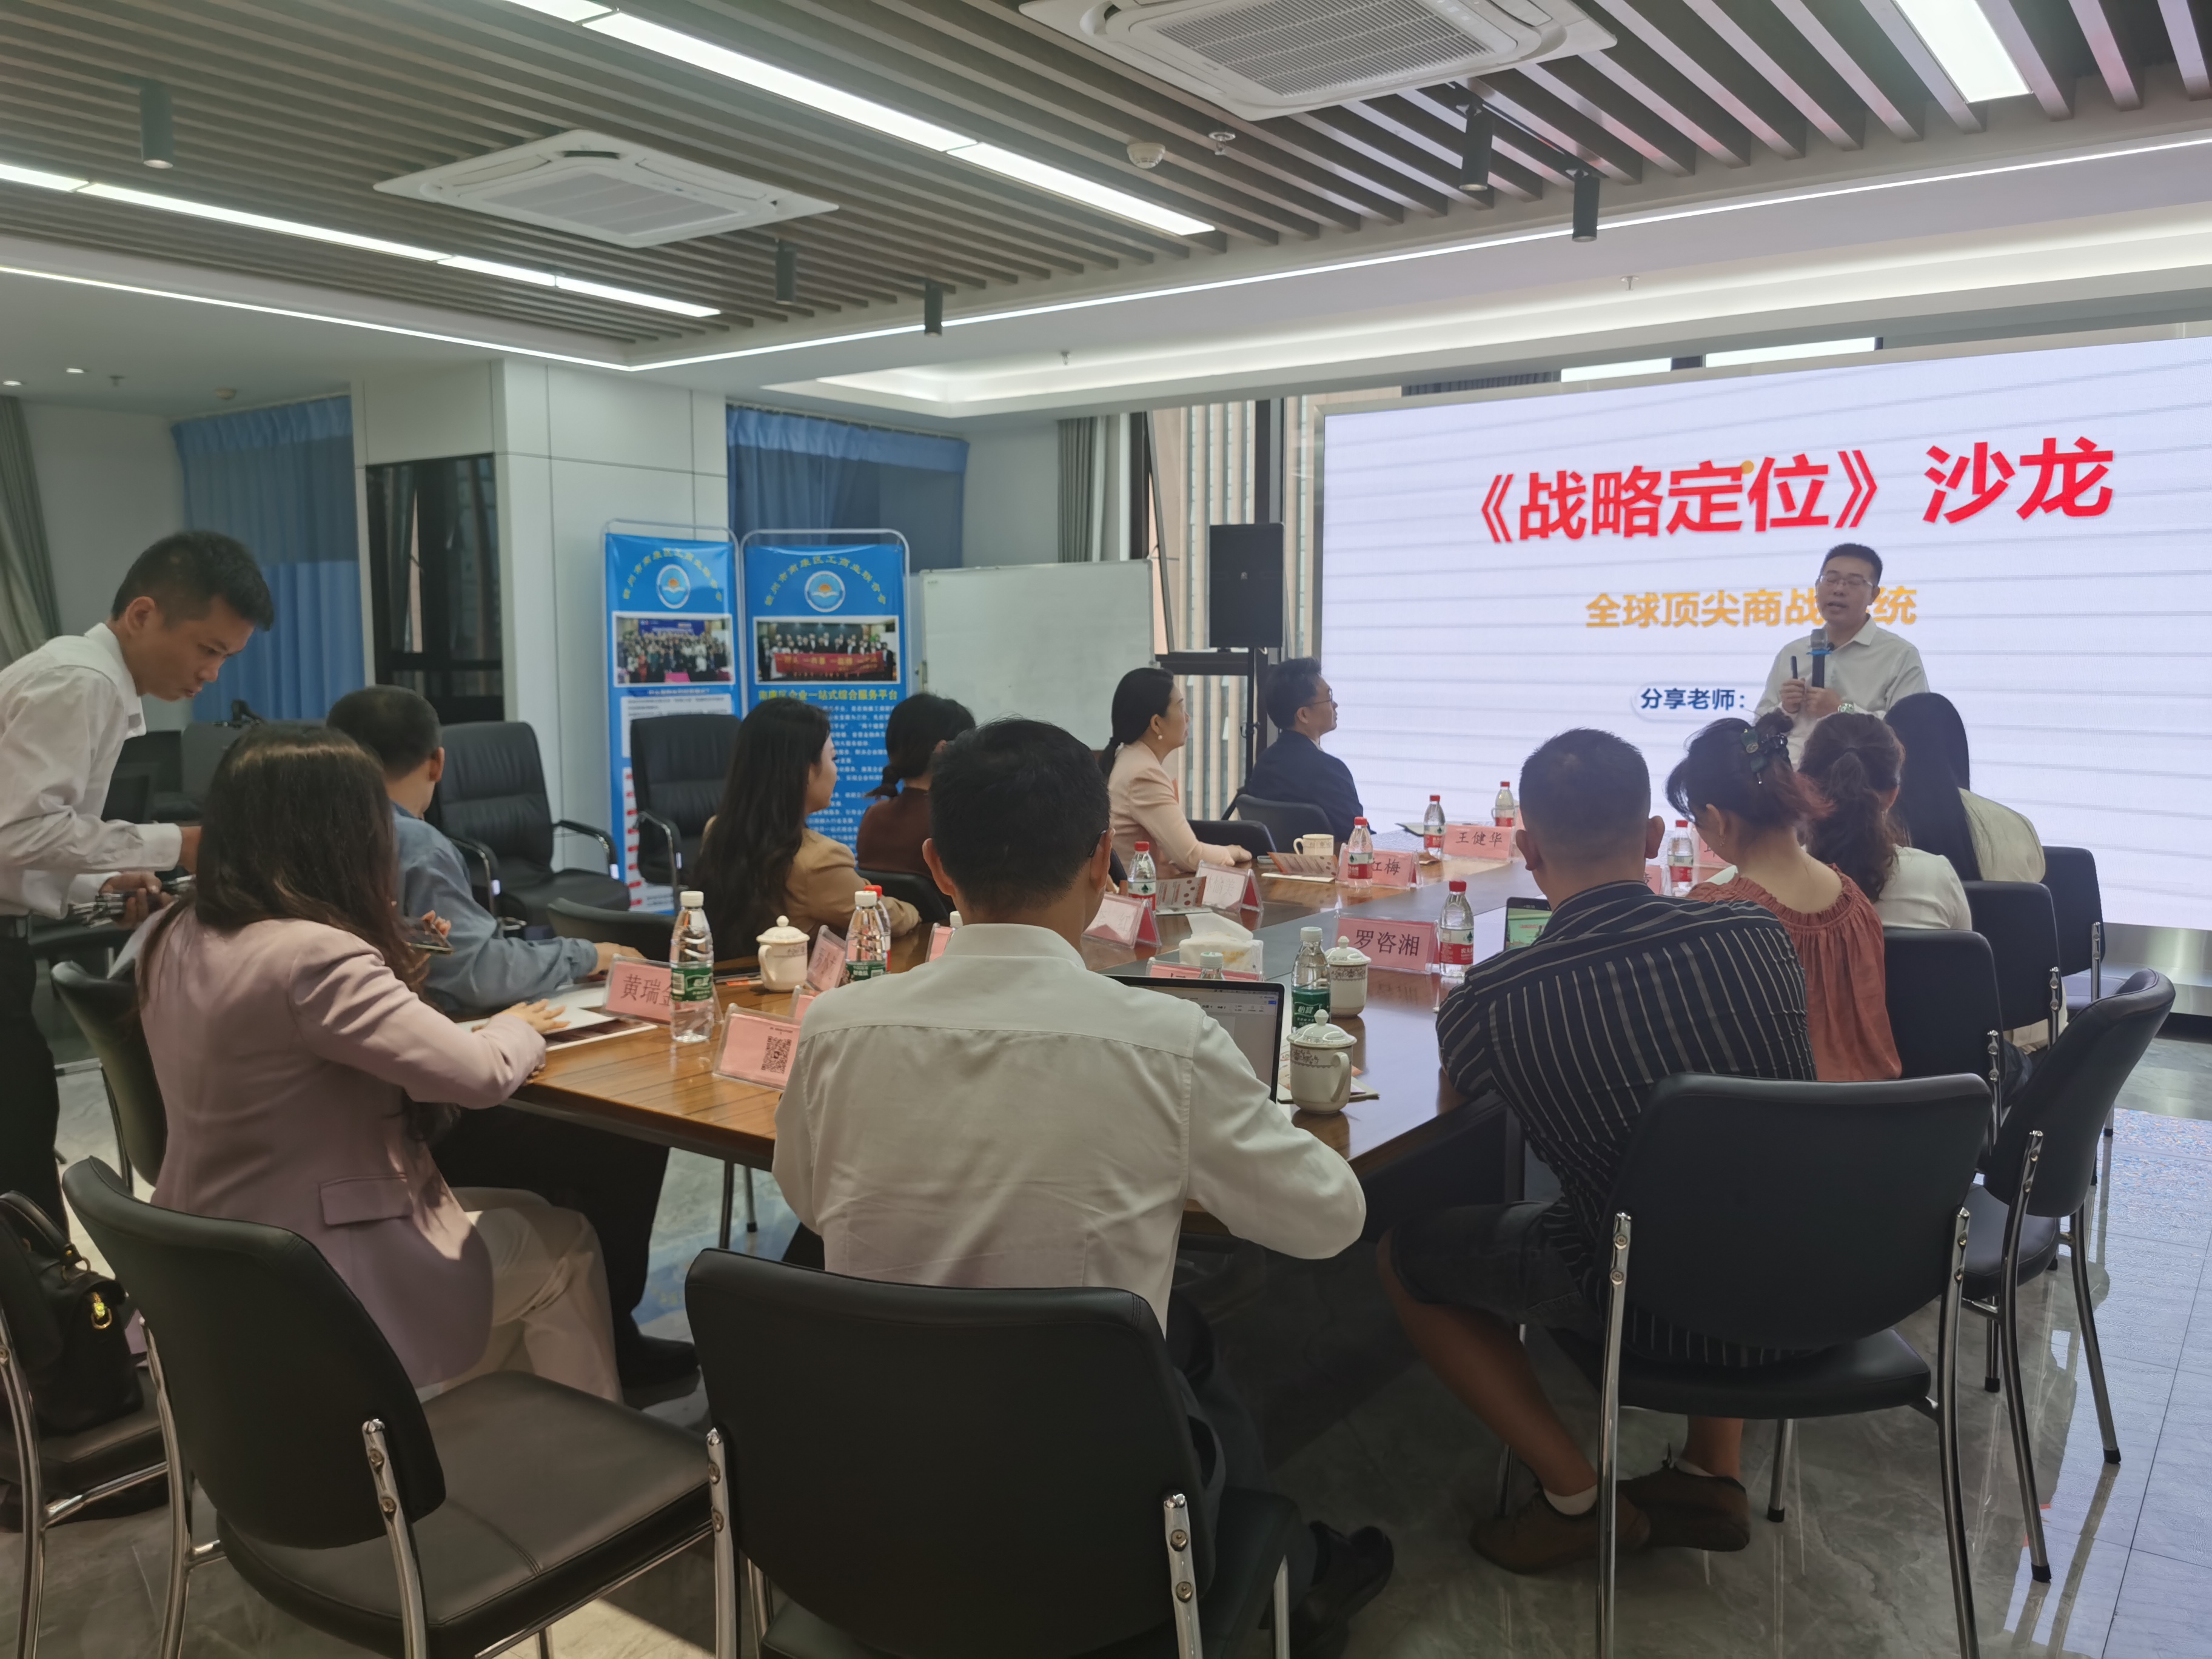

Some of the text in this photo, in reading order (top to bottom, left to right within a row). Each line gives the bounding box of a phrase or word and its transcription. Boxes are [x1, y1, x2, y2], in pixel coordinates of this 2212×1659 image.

[1481, 436, 2115, 543] 《战略定位》 沙龙
[1585, 585, 1917, 629] 全球顶尖商战统
[1455, 831, 1503, 848] 王健华
[1371, 857, 1401, 876] 红梅
[1354, 929, 1420, 956] 罗咨湘
